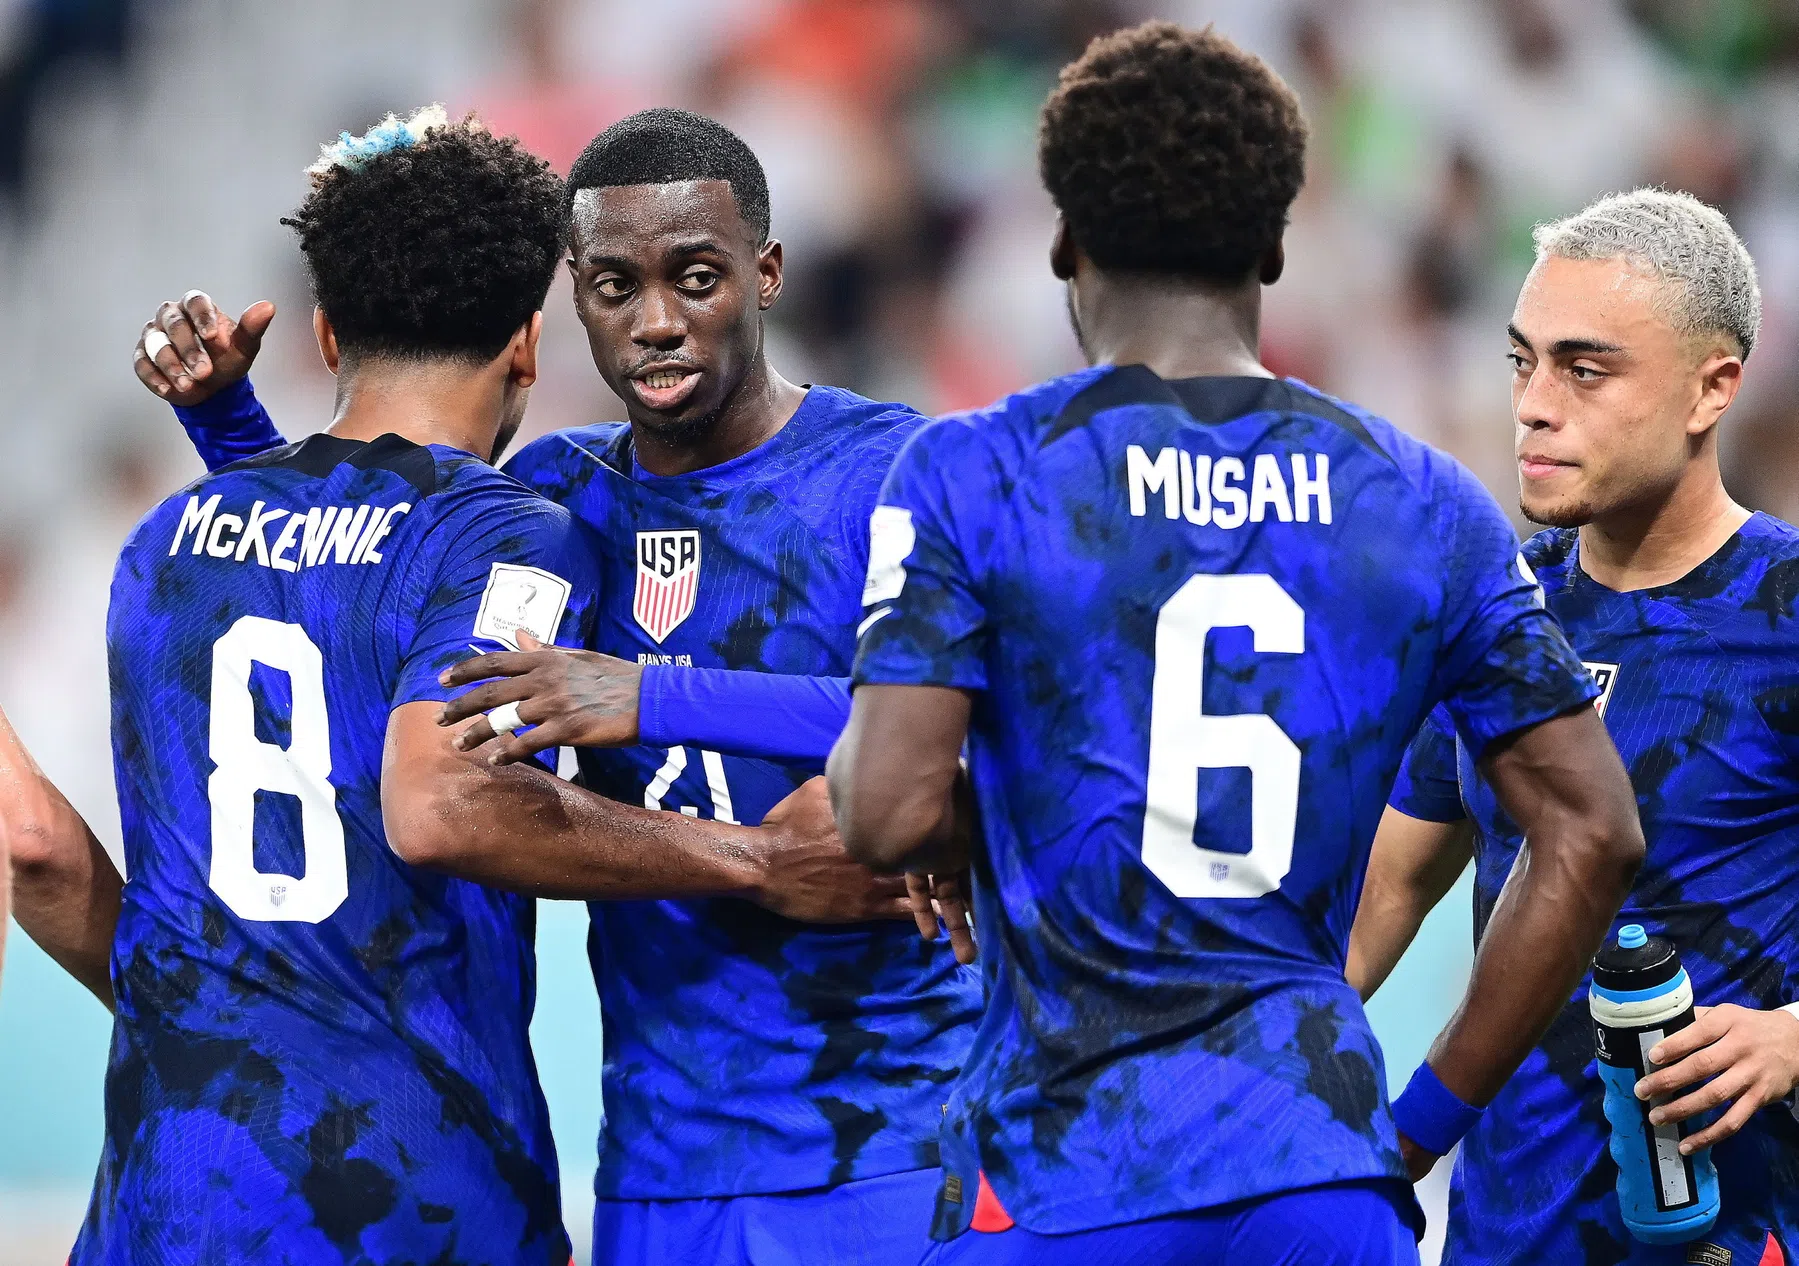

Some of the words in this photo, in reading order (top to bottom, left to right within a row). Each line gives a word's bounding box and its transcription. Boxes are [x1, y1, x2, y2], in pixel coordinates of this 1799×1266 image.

[1126, 444, 1333, 530] MUSAH
[641, 536, 695, 579] USA
[637, 653, 660, 666] IRAN
[675, 654, 693, 668] USA
[1142, 573, 1305, 899] 6
[208, 615, 349, 925] 8
[270, 886, 286, 895] USA
